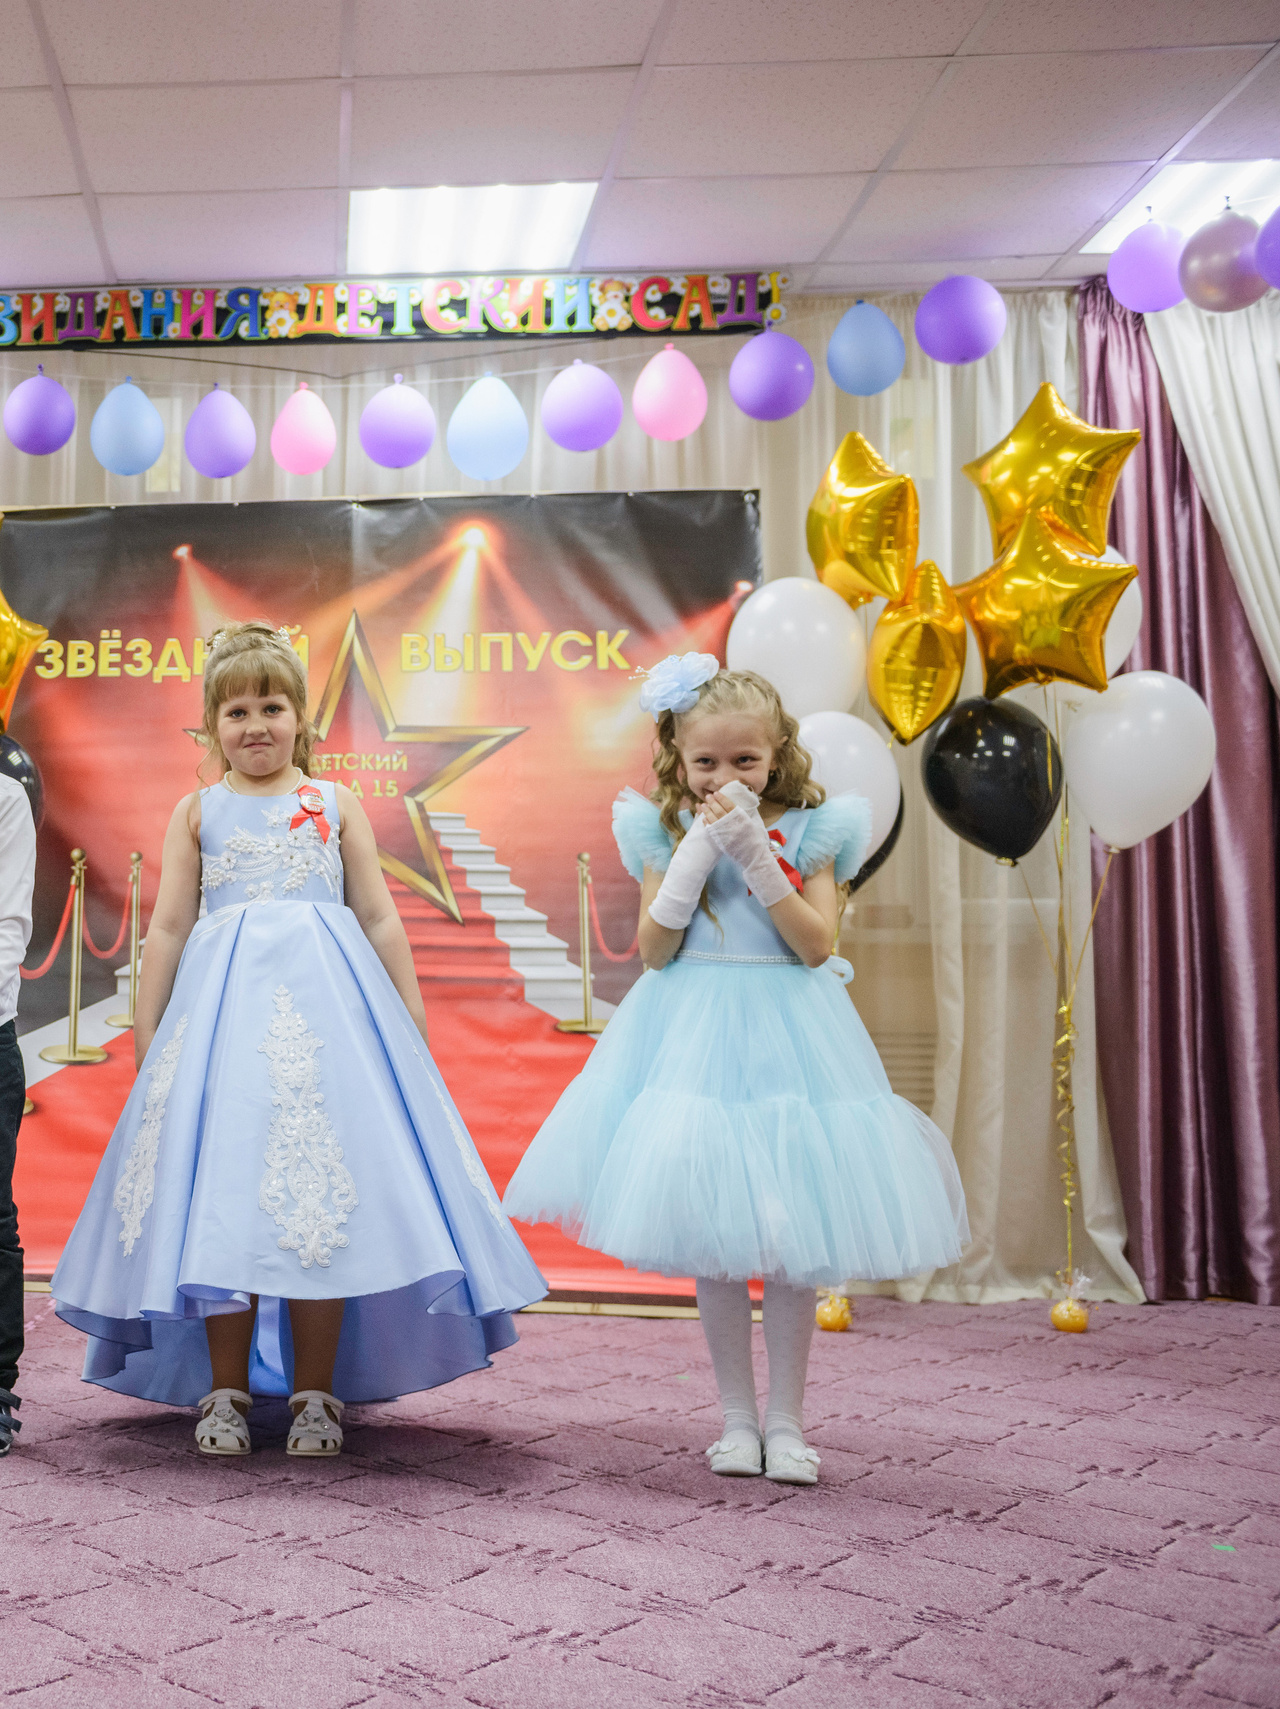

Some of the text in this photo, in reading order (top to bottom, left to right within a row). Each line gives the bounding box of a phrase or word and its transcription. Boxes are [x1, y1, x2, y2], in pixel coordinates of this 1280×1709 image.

[296, 277, 595, 337] ДЕТСКИЙ
[630, 271, 782, 333] САД!
[35, 624, 631, 683] ЗВЁЗД ВЫПУСК
[372, 779, 399, 798] 15
